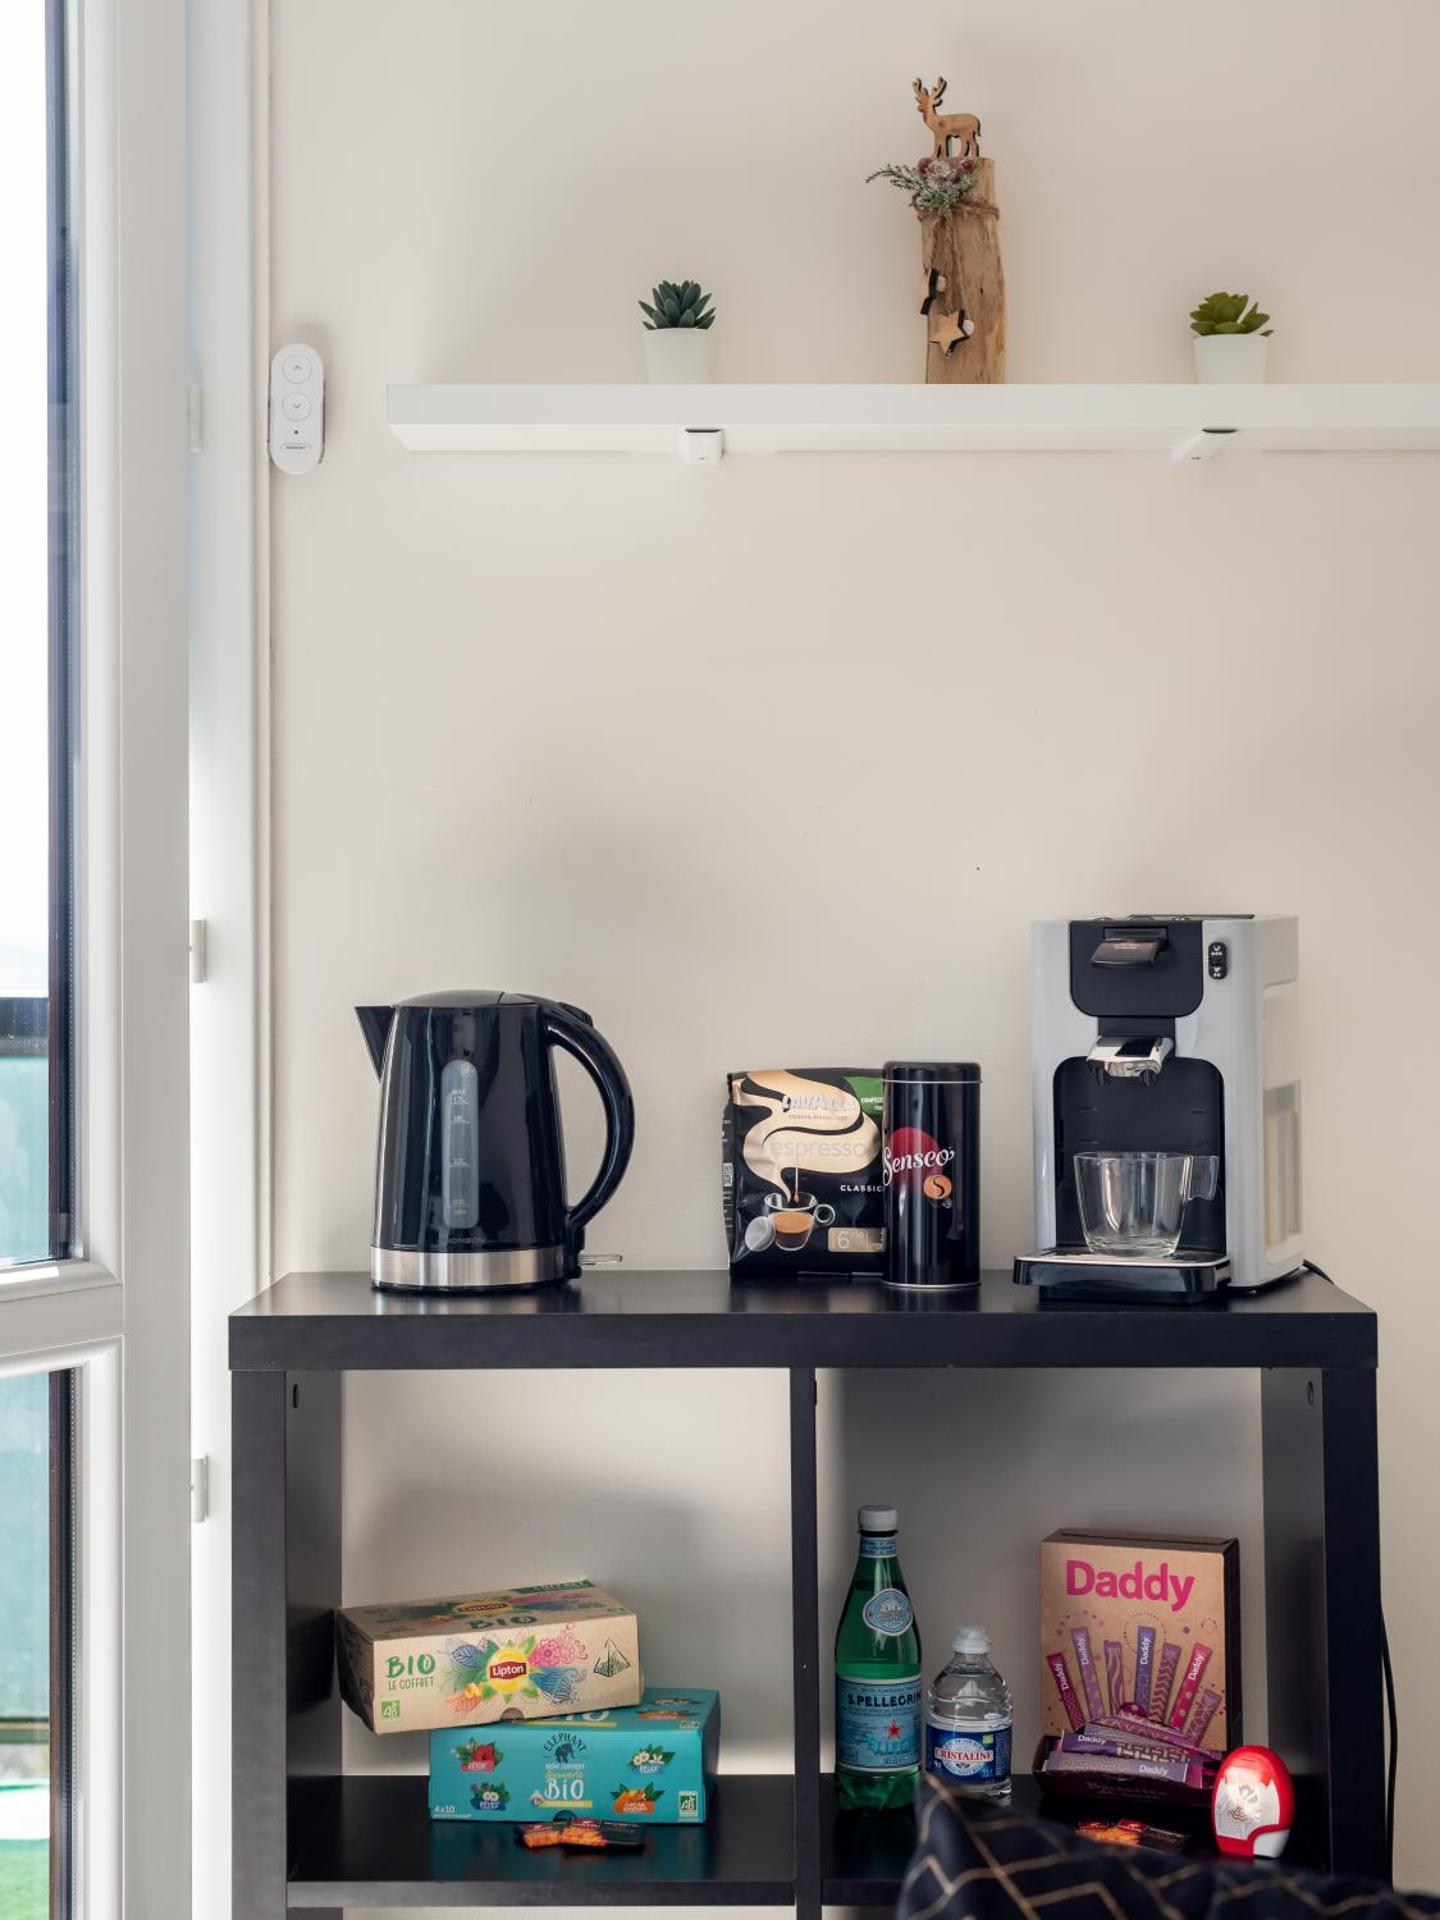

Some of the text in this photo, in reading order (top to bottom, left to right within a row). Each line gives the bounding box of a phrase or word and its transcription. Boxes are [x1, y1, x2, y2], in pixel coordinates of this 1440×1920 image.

[770, 1141, 867, 1163] espresso
[883, 1146, 955, 1186] Senseo
[840, 1184, 883, 1192] CLASSIC
[1066, 1560, 1195, 1612] Daddy
[1076, 1637, 1090, 1665] Daddy
[1139, 1637, 1151, 1665] Daddy
[385, 1653, 437, 1679] BIO
[492, 1664, 524, 1677] Lipton
[1054, 1662, 1069, 1690] Daddy
[1188, 1653, 1205, 1681] Daddy
[388, 1676, 434, 1690] LE COFFRET
[1077, 1734, 1107, 1746] Daddy
[935, 1748, 992, 1761] CRISTALINE
[1138, 1763, 1169, 1777] Daddy
